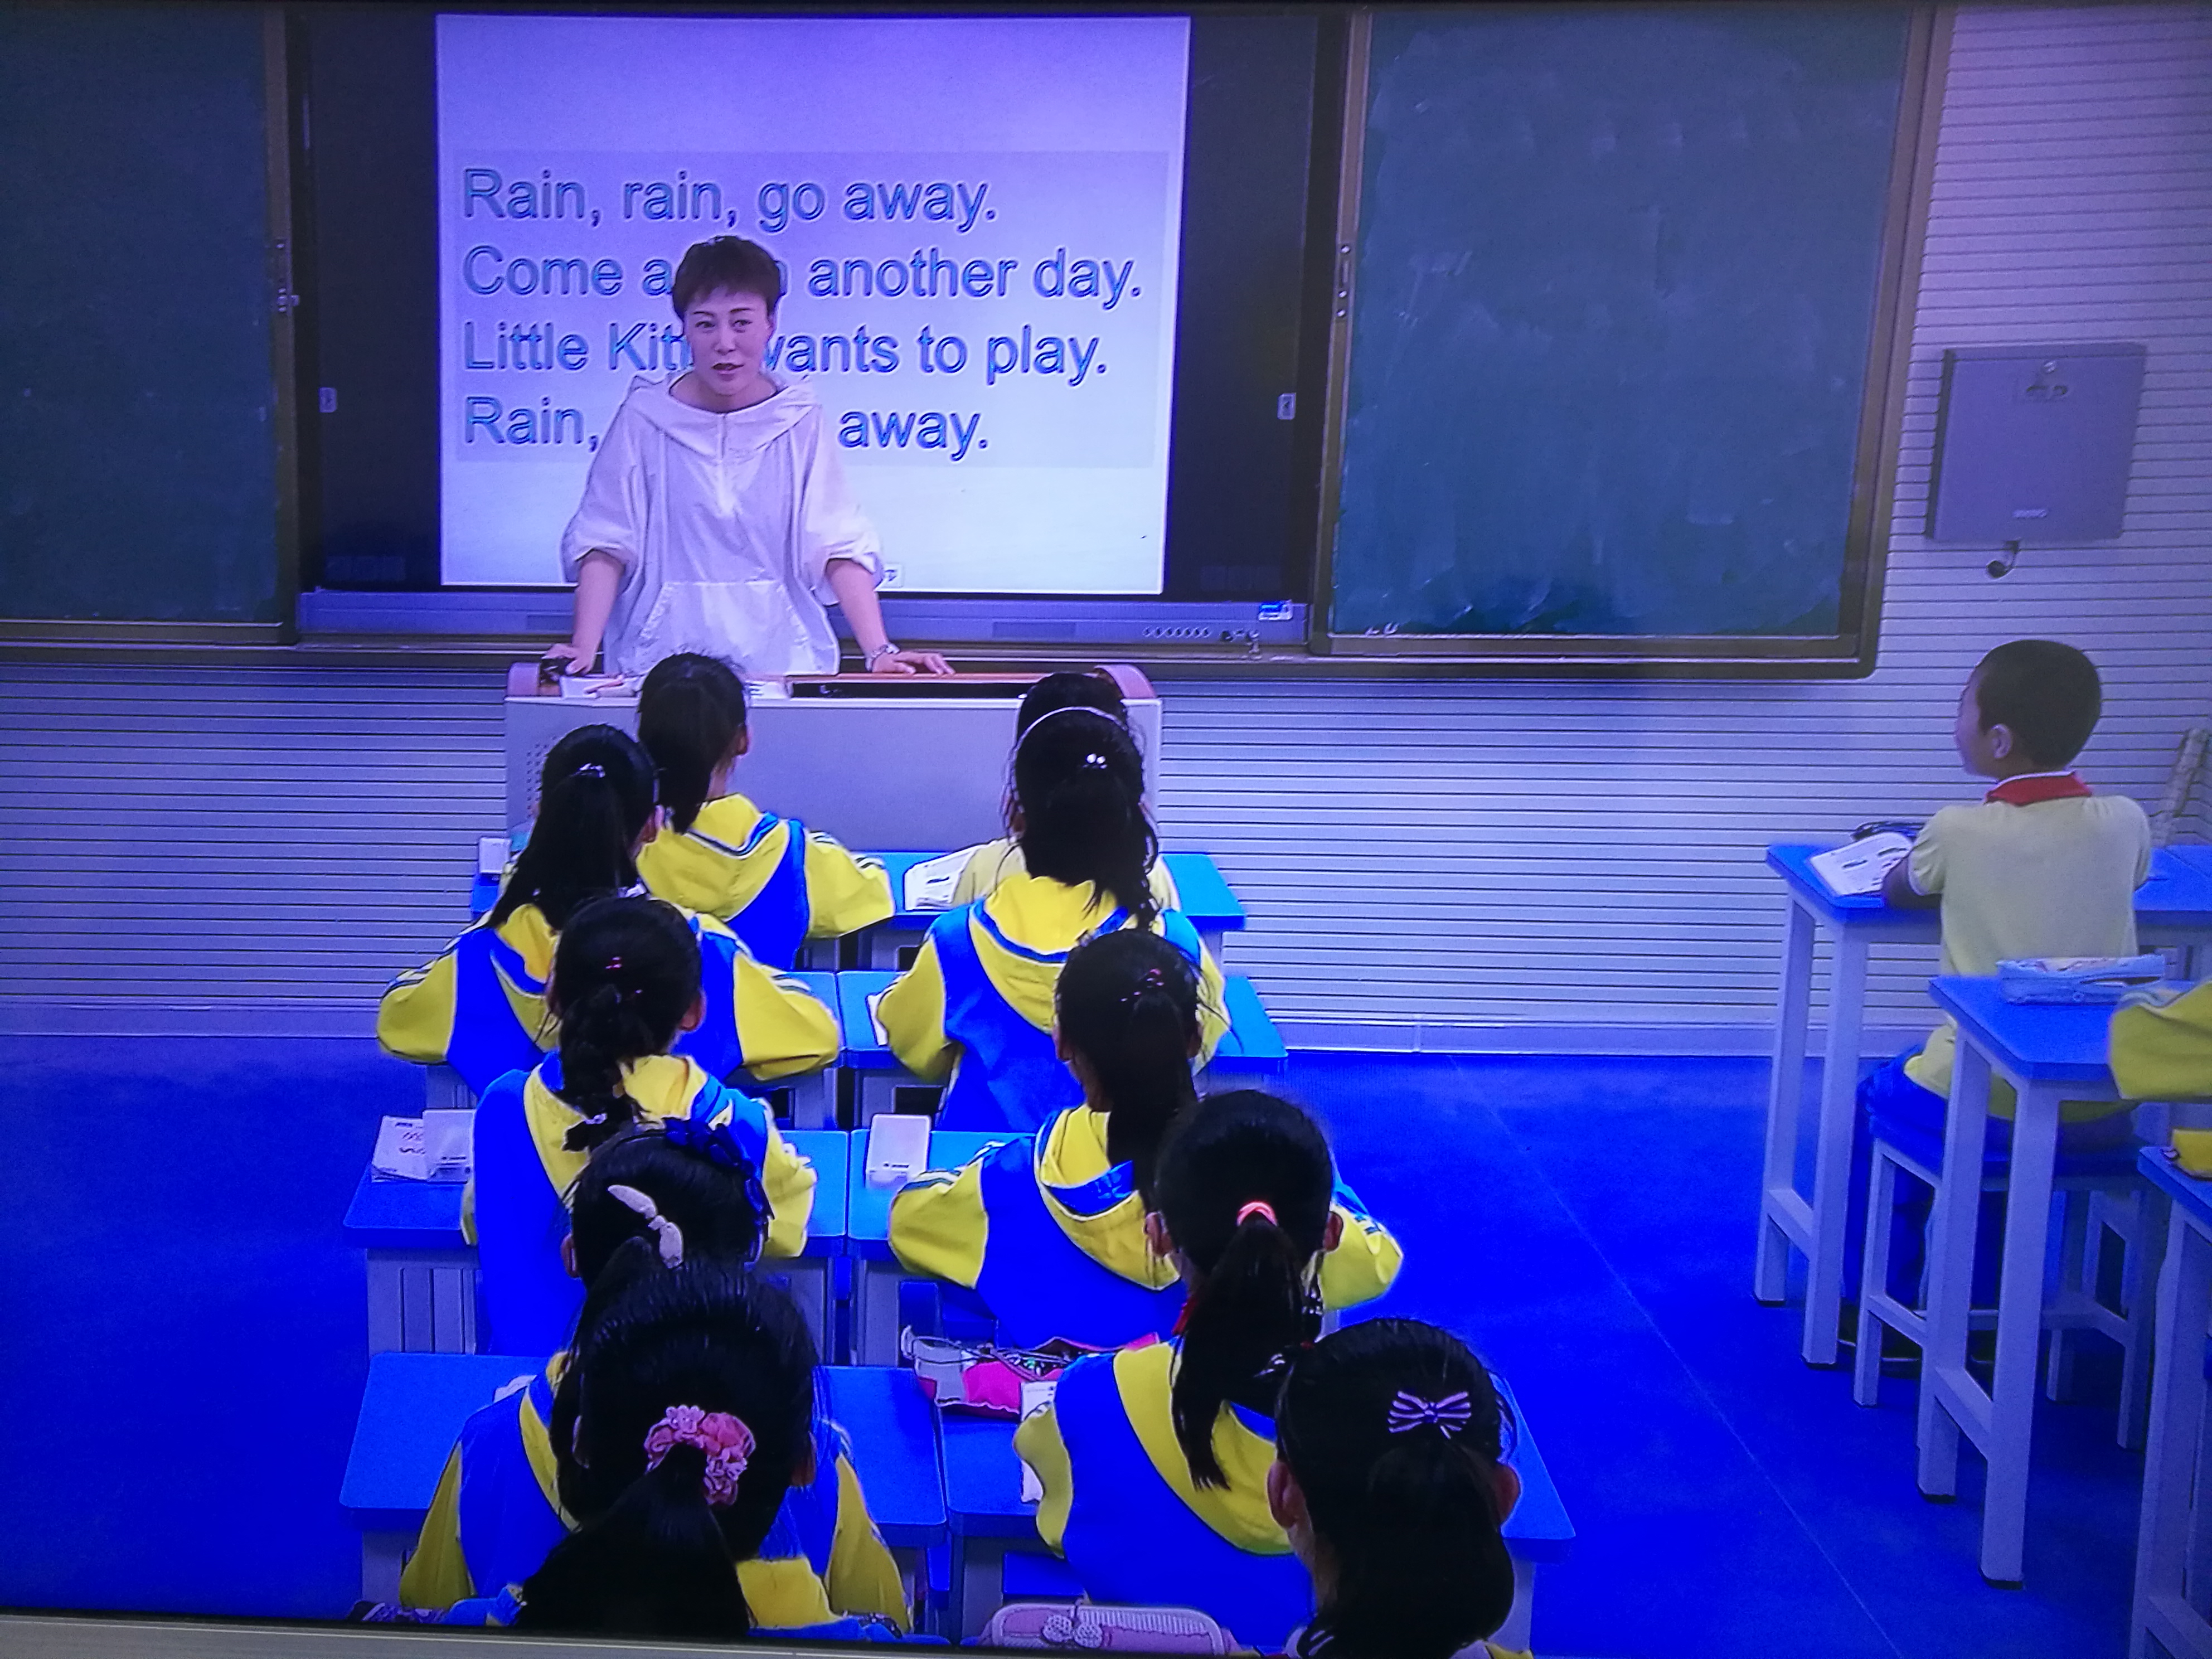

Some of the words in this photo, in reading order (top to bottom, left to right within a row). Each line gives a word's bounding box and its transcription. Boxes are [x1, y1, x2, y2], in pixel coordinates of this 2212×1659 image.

[464, 168, 601, 226] Rain,
[623, 171, 736, 227] rain,
[759, 182, 825, 233] go
[843, 182, 997, 233] away.
[463, 245, 623, 295] Come
[808, 248, 1018, 298] another
[1033, 247, 1141, 310] day.
[464, 322, 589, 370] Little
[917, 324, 967, 373] to
[986, 324, 1107, 387] play.
[464, 396, 599, 453] Rain,
[838, 410, 989, 462] away.
